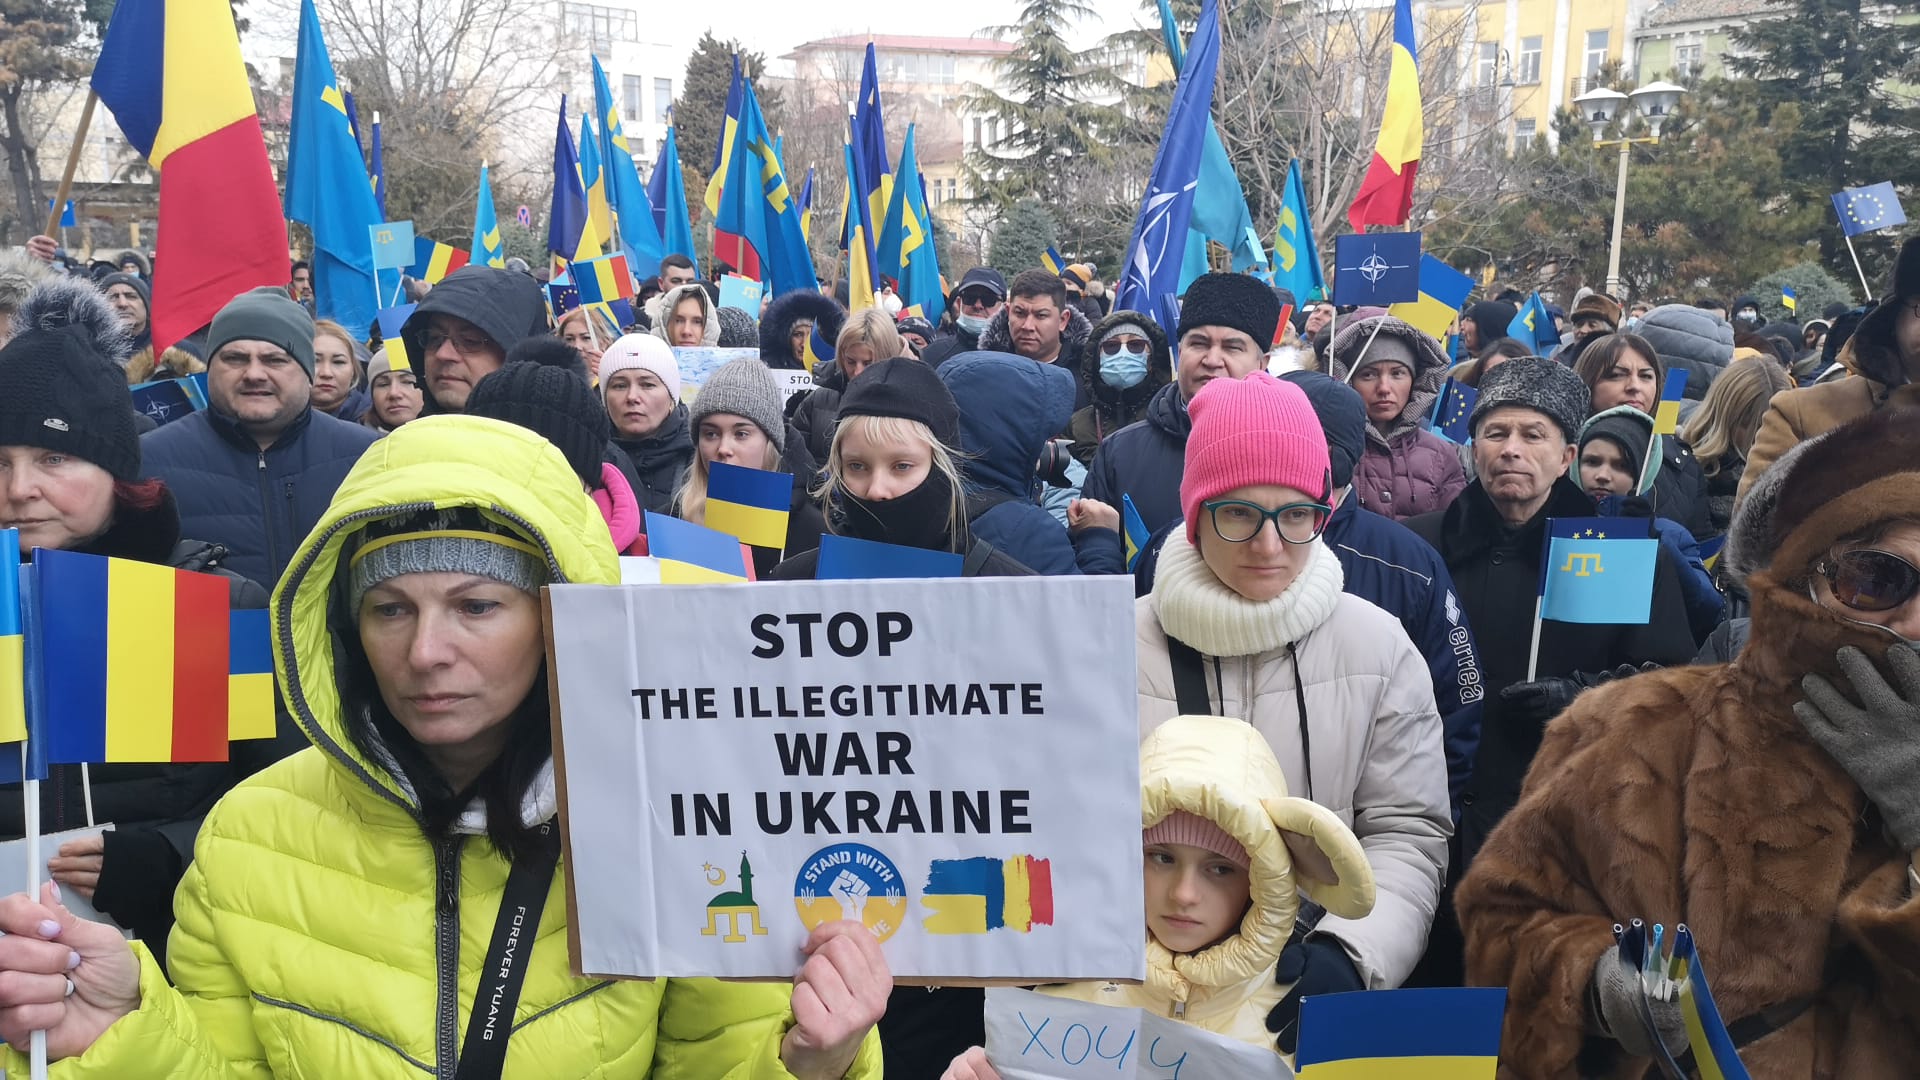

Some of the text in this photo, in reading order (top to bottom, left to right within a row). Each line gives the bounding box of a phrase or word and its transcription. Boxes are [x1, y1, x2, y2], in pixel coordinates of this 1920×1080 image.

[790, 375, 811, 385] STO
[750, 611, 913, 659] STOP
[631, 683, 1044, 720] THE ILLEGITIMATE
[773, 731, 915, 777] WAR
[670, 790, 1032, 836] IN UKRAINE
[804, 850, 896, 883] STAND WITH
[482, 905, 527, 1041] FOREVER YUANG
